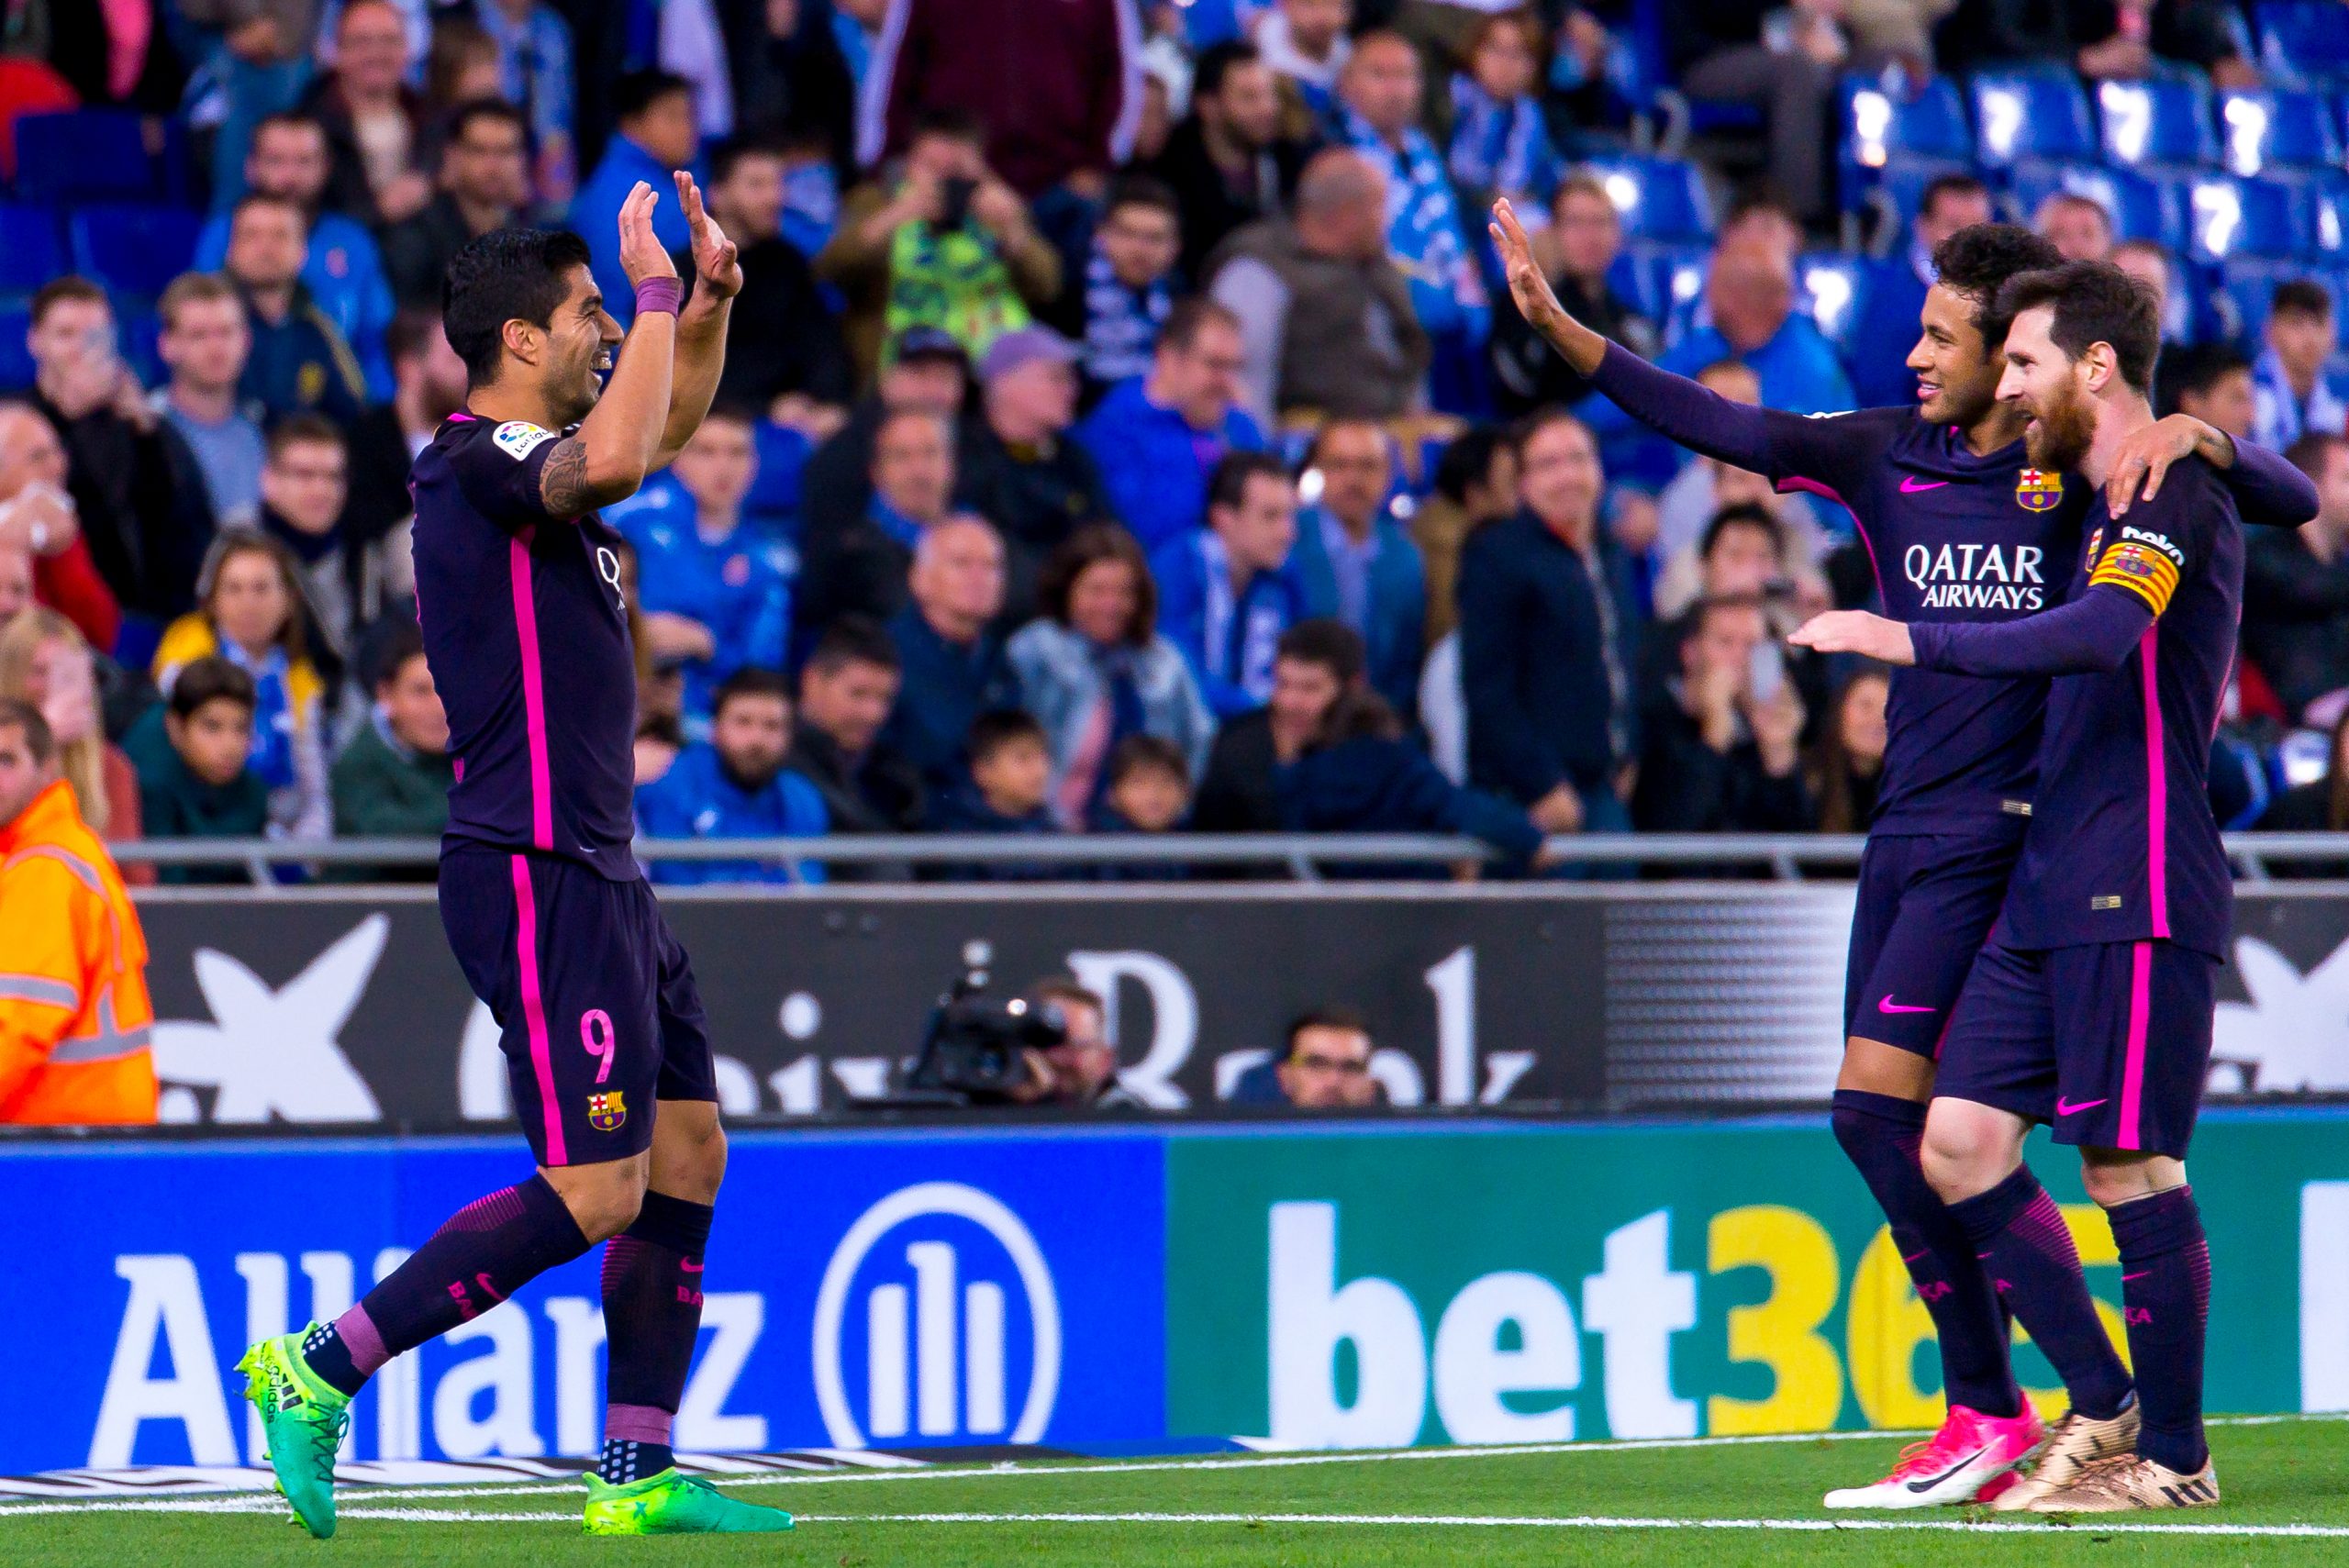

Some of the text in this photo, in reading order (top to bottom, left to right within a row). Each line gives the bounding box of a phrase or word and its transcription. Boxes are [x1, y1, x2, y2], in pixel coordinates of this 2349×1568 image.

[1904, 543, 2044, 590] QATAR
[1921, 584, 2043, 610] AIRWAYS
[581, 1009, 615, 1084] 9
[267, 1364, 282, 1424] adidas
